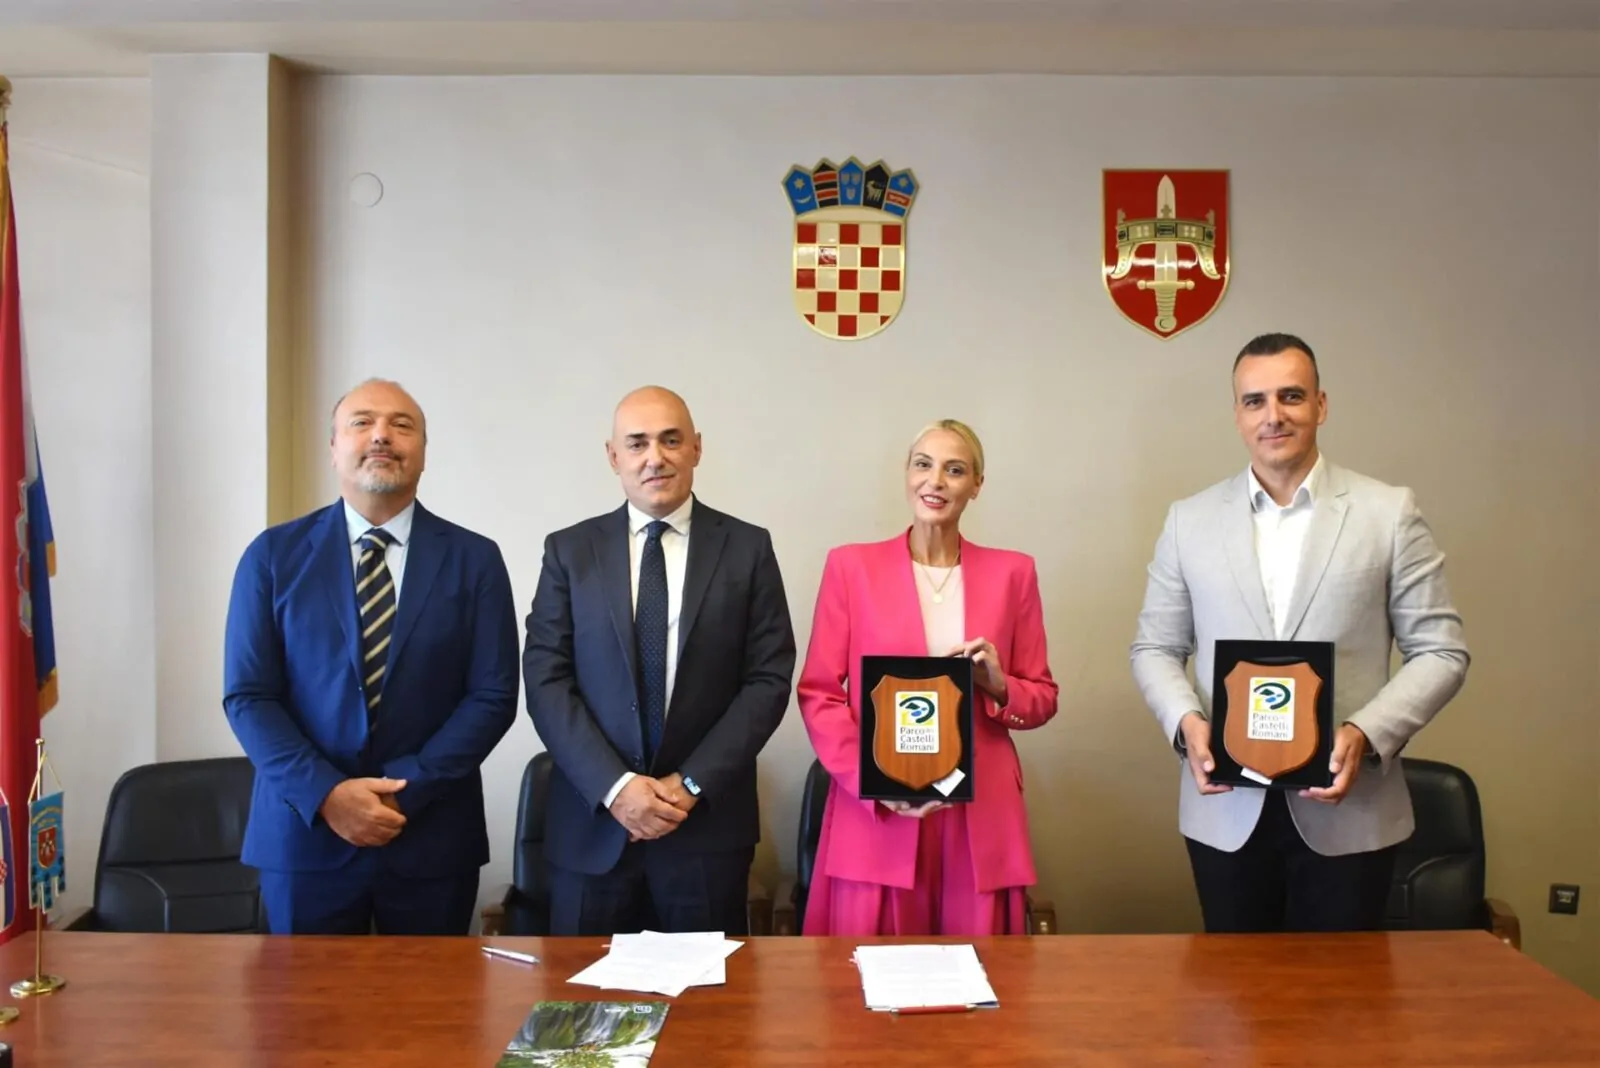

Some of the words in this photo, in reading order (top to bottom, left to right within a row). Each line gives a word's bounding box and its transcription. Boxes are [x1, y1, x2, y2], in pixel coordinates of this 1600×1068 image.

[1253, 713, 1279, 721] Parco
[1253, 720, 1288, 730] Castelli
[900, 727, 925, 735] Parco
[900, 734, 934, 743] Castelli
[900, 743, 934, 751] Romani
